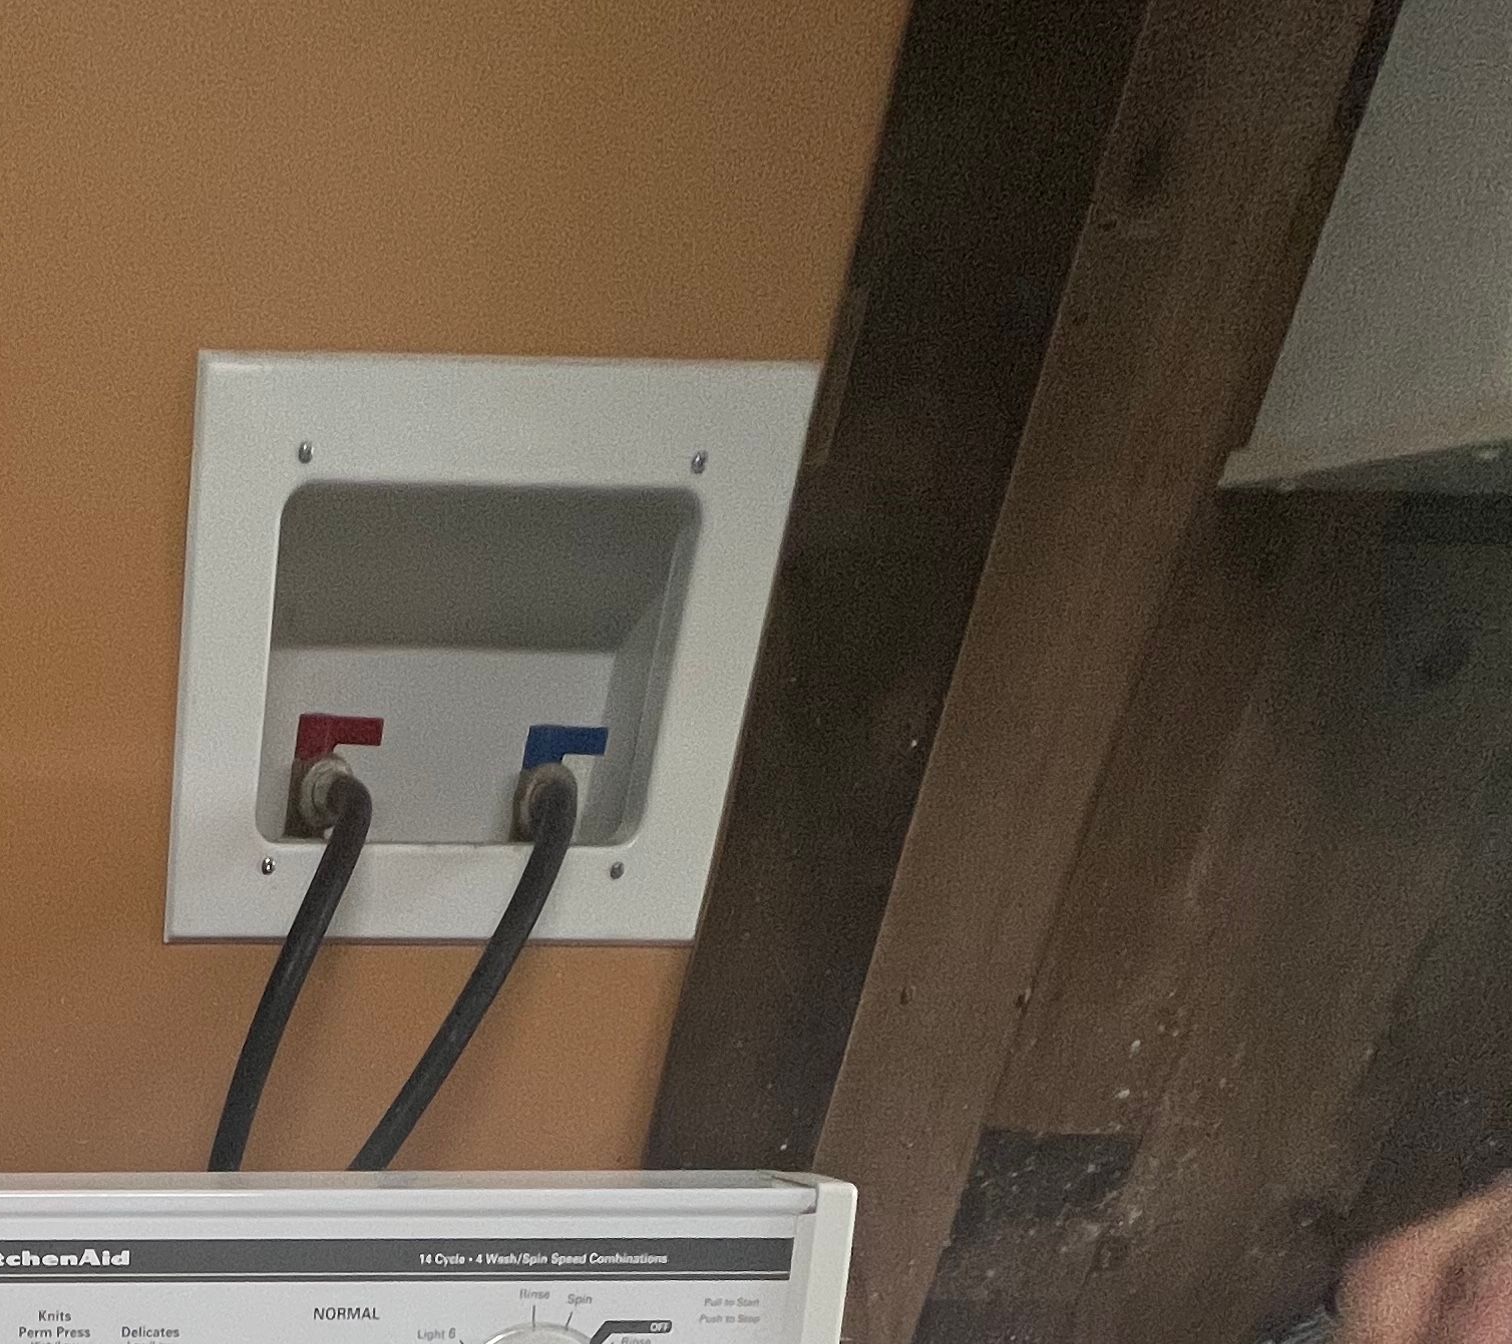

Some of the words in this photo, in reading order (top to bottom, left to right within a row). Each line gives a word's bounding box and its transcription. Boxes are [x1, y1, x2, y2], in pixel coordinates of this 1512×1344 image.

[419, 1253, 432, 1265] 14
[434, 1253, 466, 1267] Cycle
[475, 1253, 483, 1265] 4
[486, 1252, 548, 1267] Wash/Spin
[551, 1252, 587, 1267] Speed
[589, 1252, 668, 1265] Combinations
[519, 1288, 550, 1300] Rinse
[567, 1293, 593, 1307] Spin
[38, 1310, 73, 1323] Knits
[313, 1307, 381, 1321] NORMAL
[18, 1326, 53, 1339] Perm
[56, 1326, 91, 1339] Press
[121, 1326, 180, 1339] Delicates
[417, 1329, 445, 1341] Light
[448, 1327, 456, 1339] 6
[650, 1322, 670, 1333] OFF
